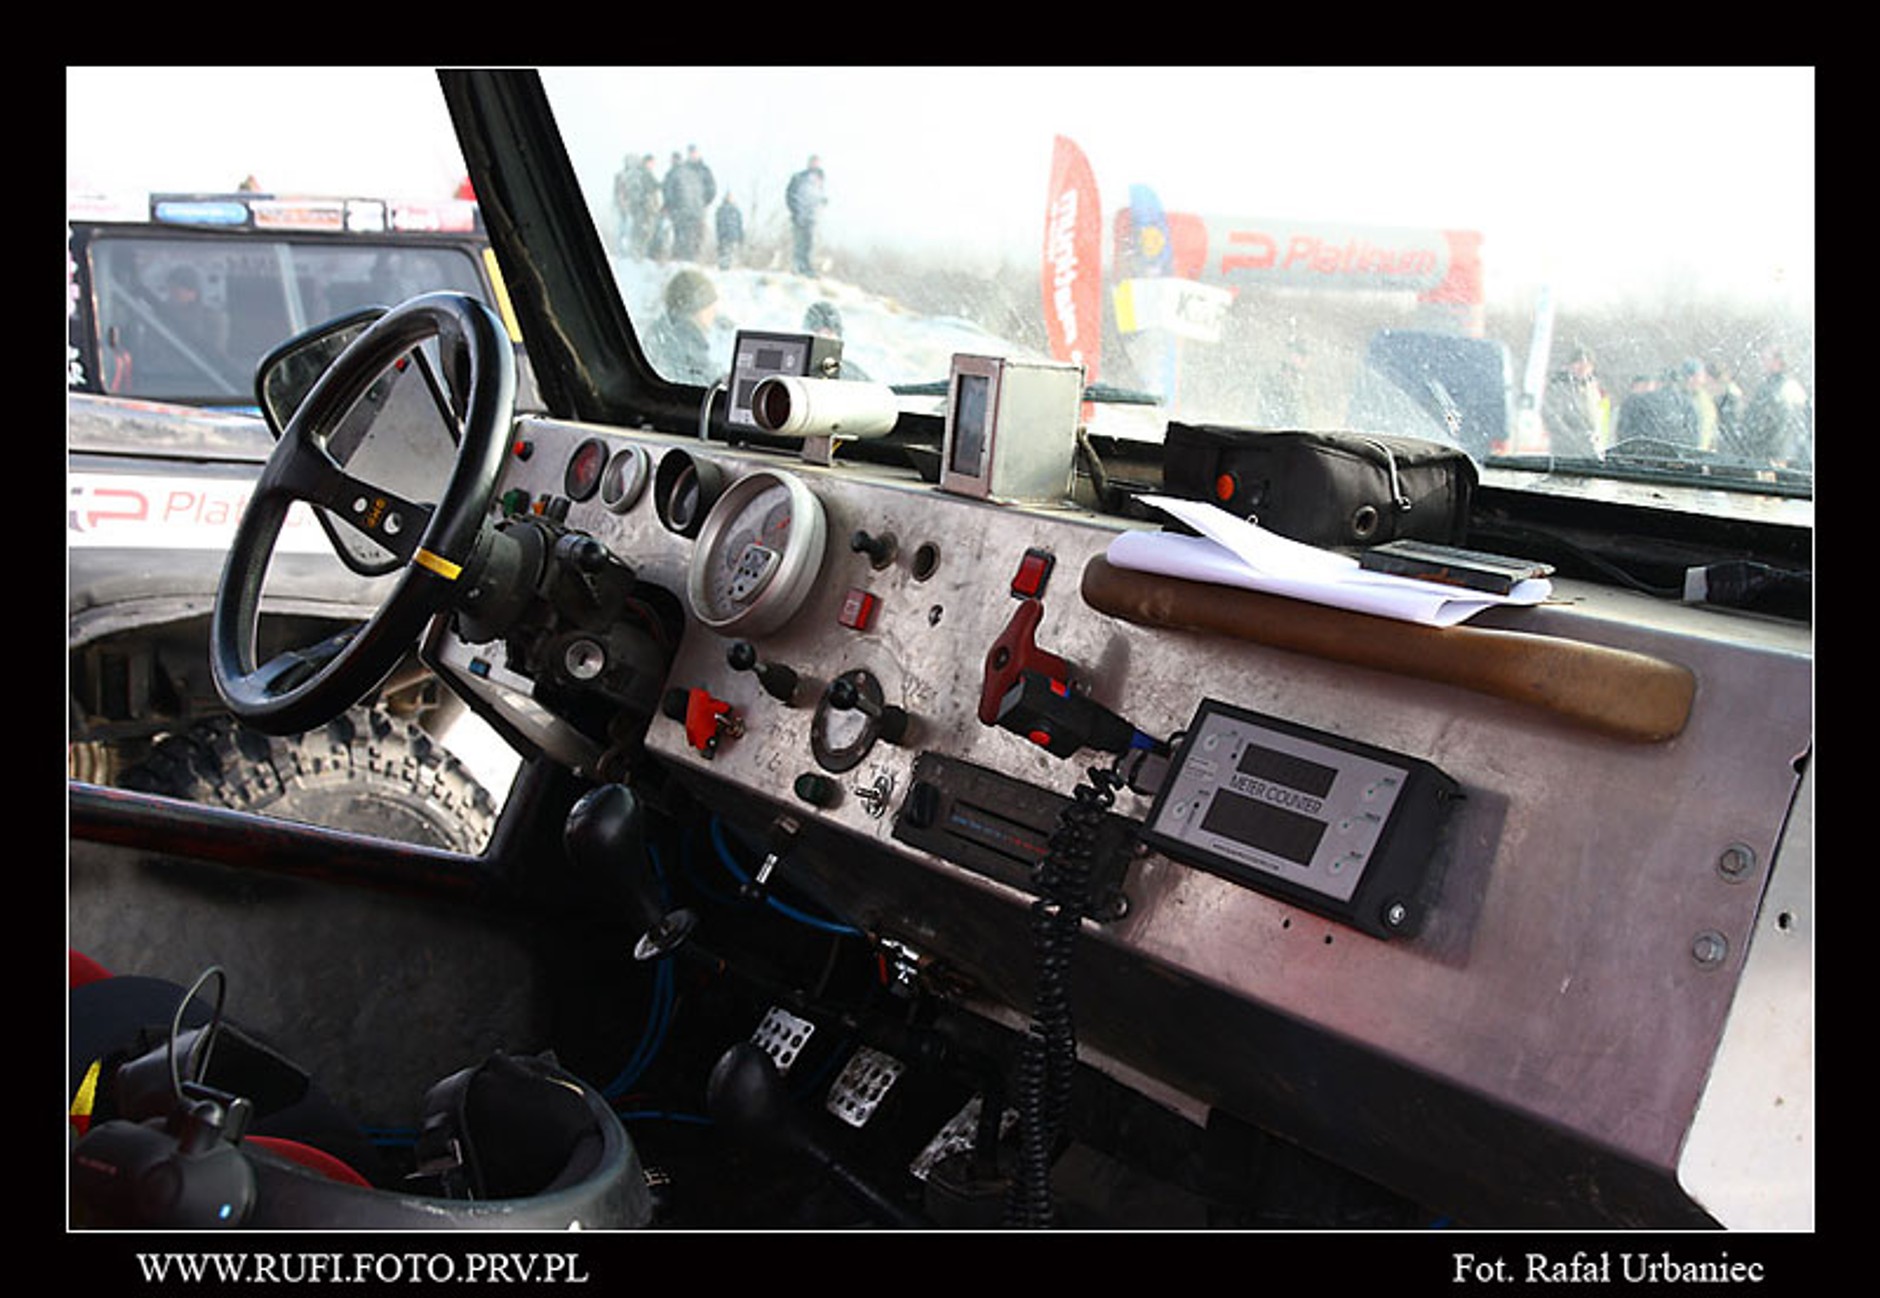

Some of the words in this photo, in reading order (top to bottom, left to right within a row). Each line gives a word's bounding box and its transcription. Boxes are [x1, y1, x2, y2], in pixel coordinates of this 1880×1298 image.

[1280, 234, 1437, 278] Platinum
[1229, 774, 1266, 798] METER
[1266, 786, 1323, 814] COUNTER
